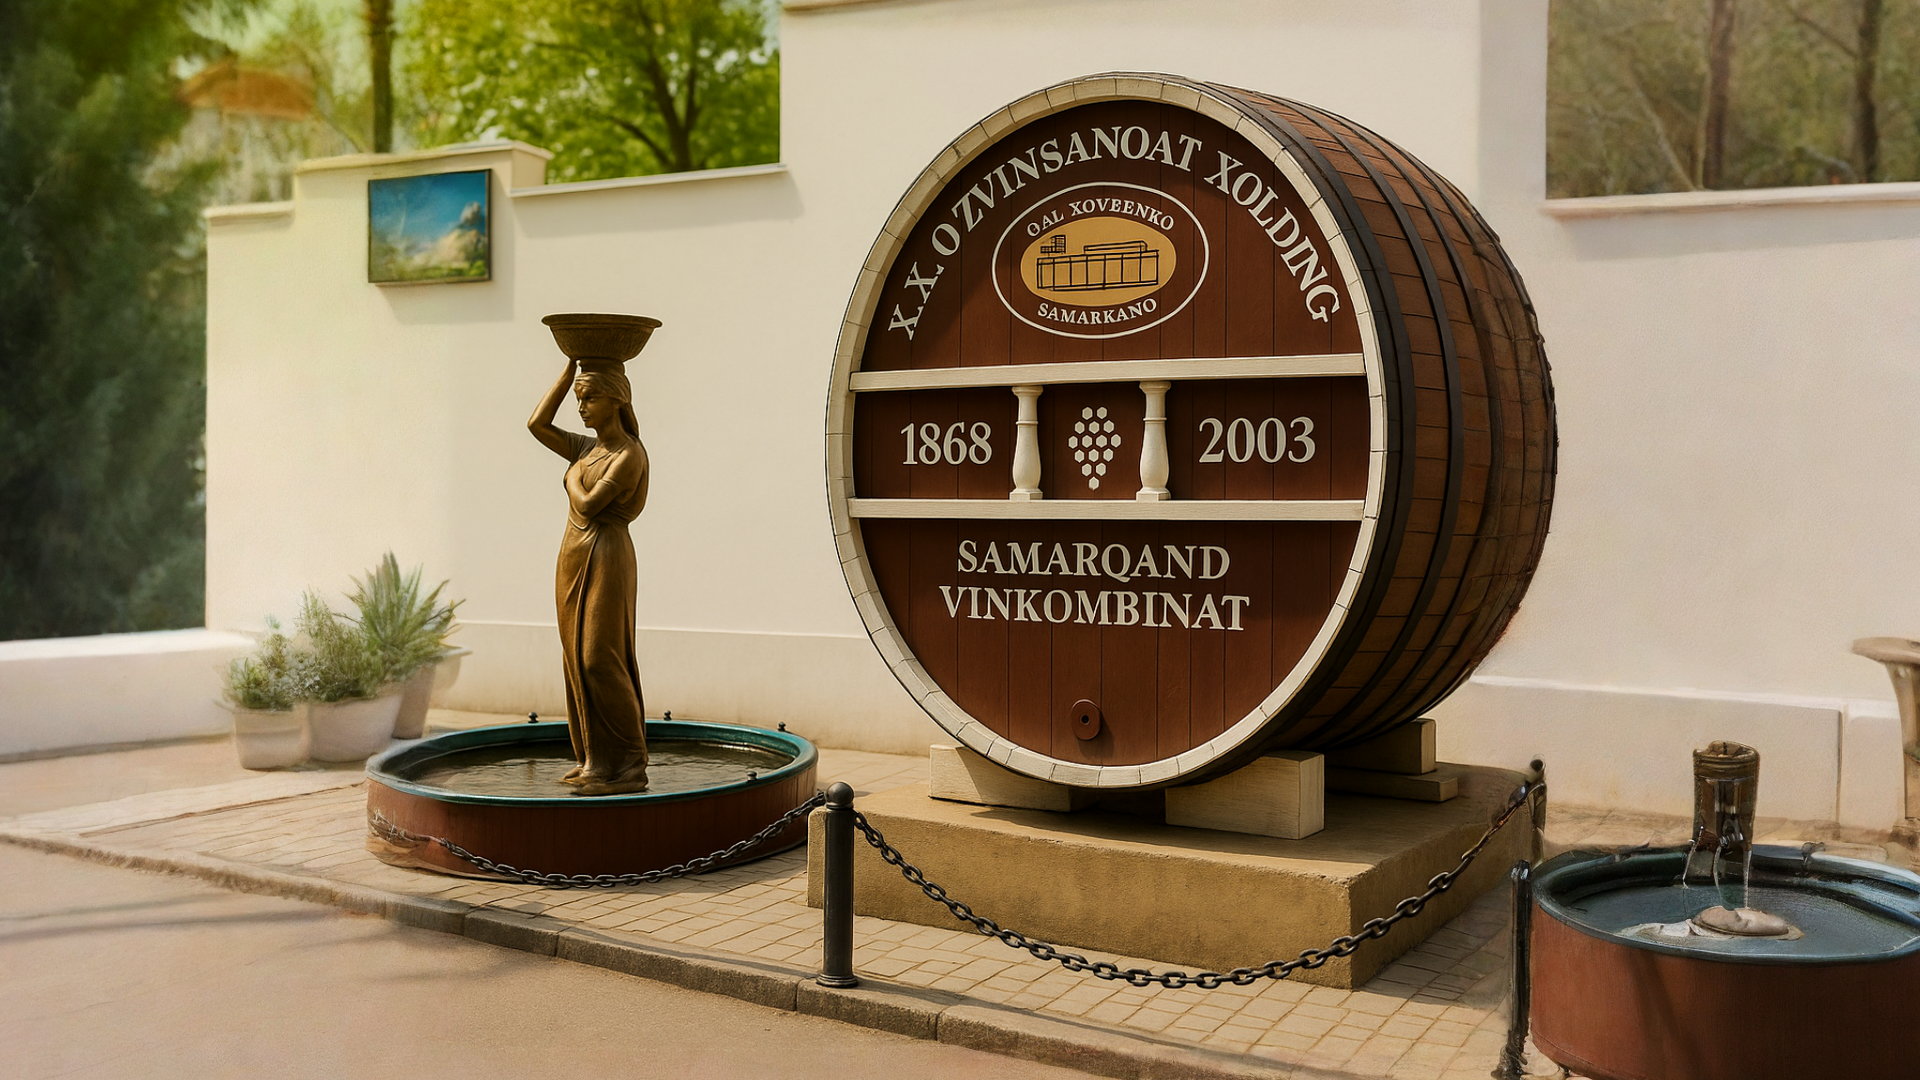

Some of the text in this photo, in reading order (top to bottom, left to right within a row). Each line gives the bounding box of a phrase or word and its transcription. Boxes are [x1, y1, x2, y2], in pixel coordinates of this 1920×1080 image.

[1068, 197, 1175, 231] XOVEENKO
[1204, 150, 1341, 323] XOLDING
[900, 421, 993, 465] 1868
[1198, 416, 1316, 463] 2003
[957, 539, 1230, 583] SAMARQAND
[938, 585, 1250, 631] VINKOMBINAT
